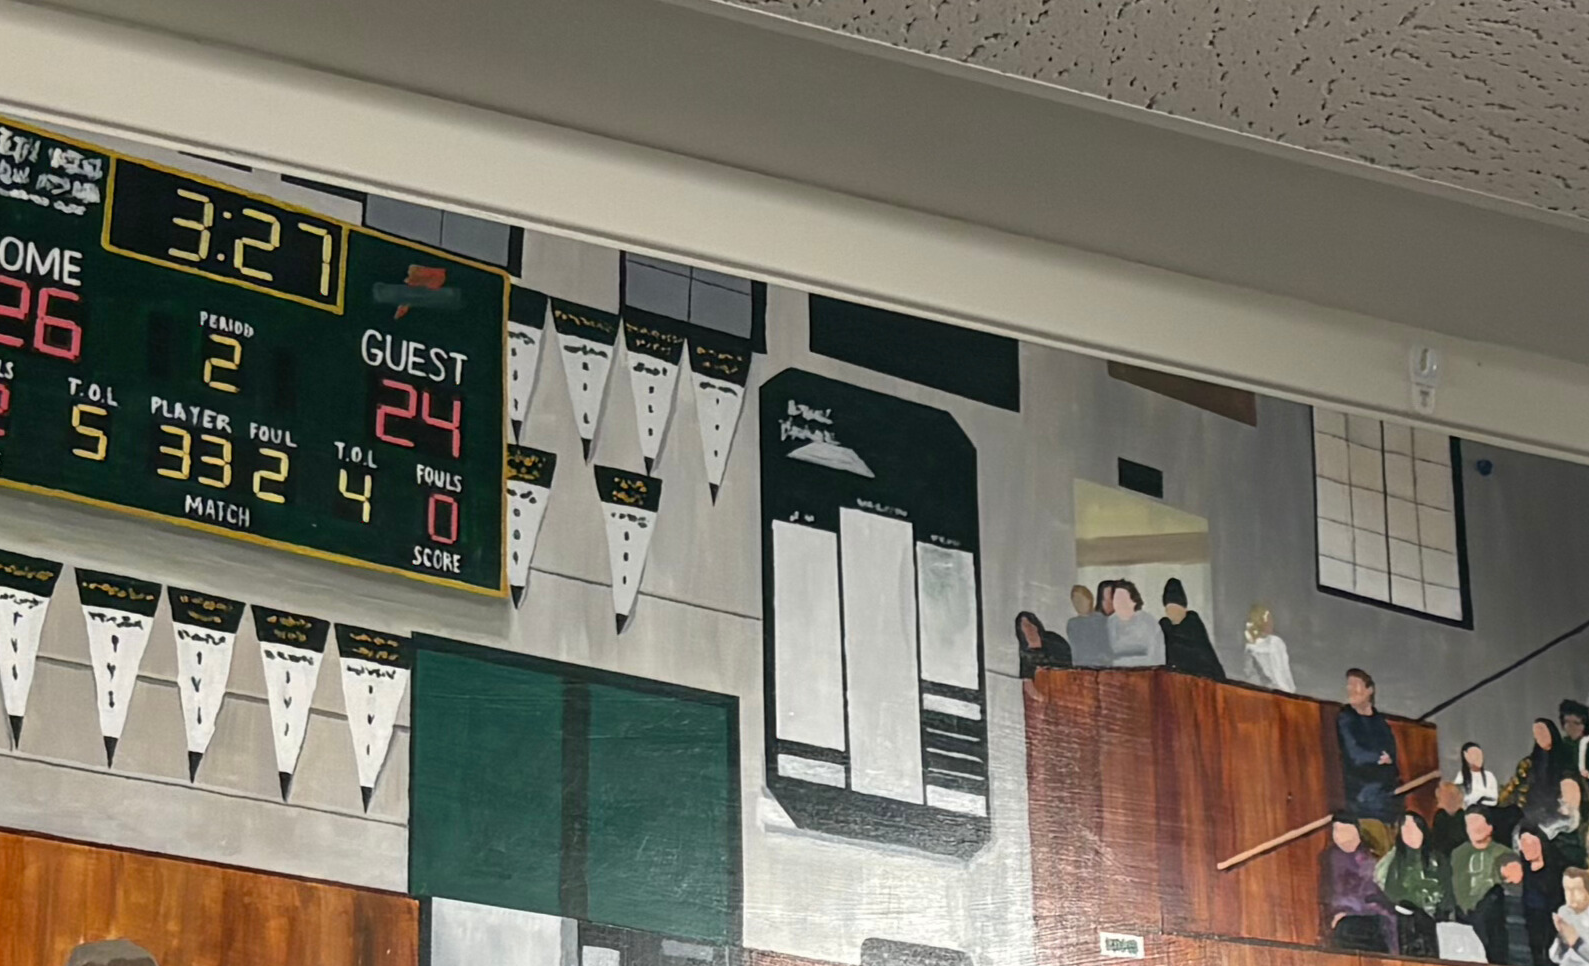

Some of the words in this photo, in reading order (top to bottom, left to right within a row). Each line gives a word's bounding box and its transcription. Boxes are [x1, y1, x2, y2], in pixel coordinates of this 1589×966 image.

[167, 189, 333, 297] 3:27
[199, 311, 254, 338] PERIOD
[203, 334, 242, 394] 2
[361, 329, 468, 385] GUEST
[72, 403, 108, 461] 5
[150, 396, 233, 434] PLAYER
[250, 422, 298, 447] FOUL
[376, 379, 461, 458] 24
[157, 425, 232, 488] 33
[253, 448, 289, 503] 2
[416, 464, 462, 492] FOULS
[185, 494, 250, 528] MATCH
[338, 468, 372, 523] 4
[428, 493, 458, 544] 0
[412, 545, 461, 573] SCORE
